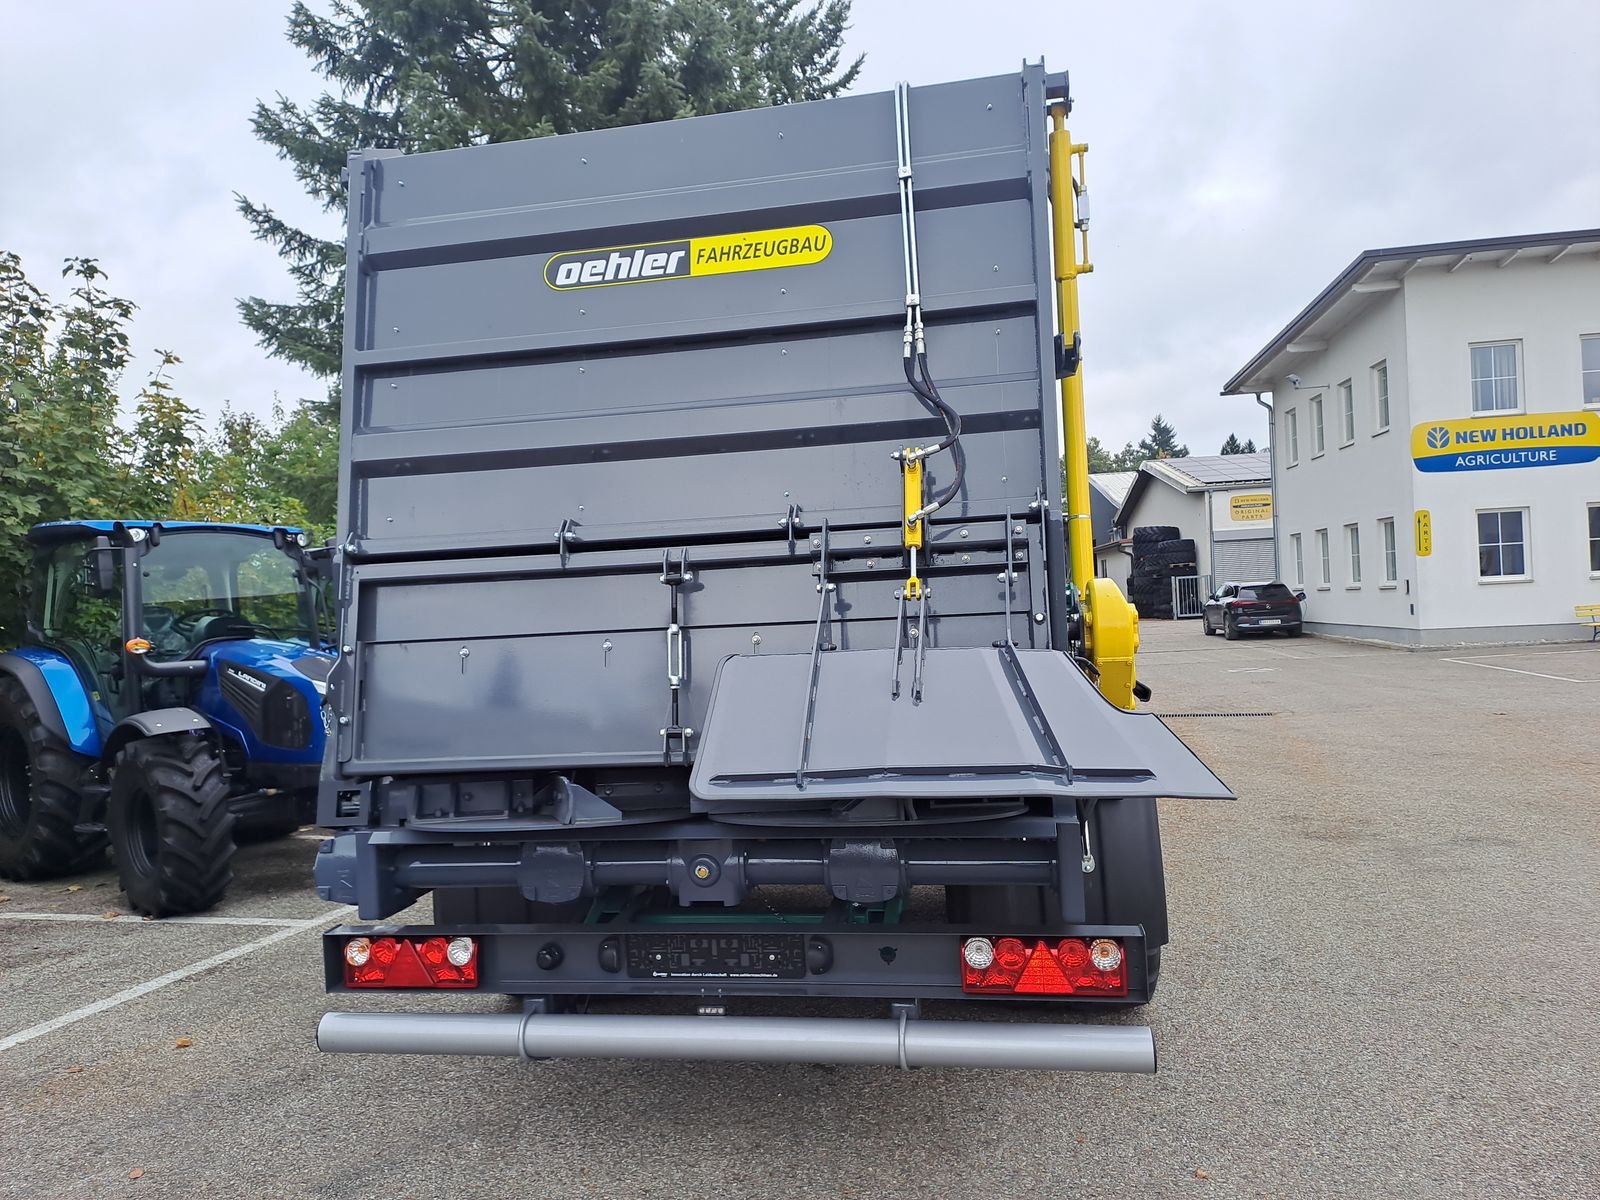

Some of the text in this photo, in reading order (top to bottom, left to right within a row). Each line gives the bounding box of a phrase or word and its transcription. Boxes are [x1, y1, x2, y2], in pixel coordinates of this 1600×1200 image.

[555, 234, 827, 286] oehler FAHRZEUGBAU
[1455, 422, 1587, 444] NEW HOLLAND
[1455, 449, 1558, 467] AGRICULTURE
